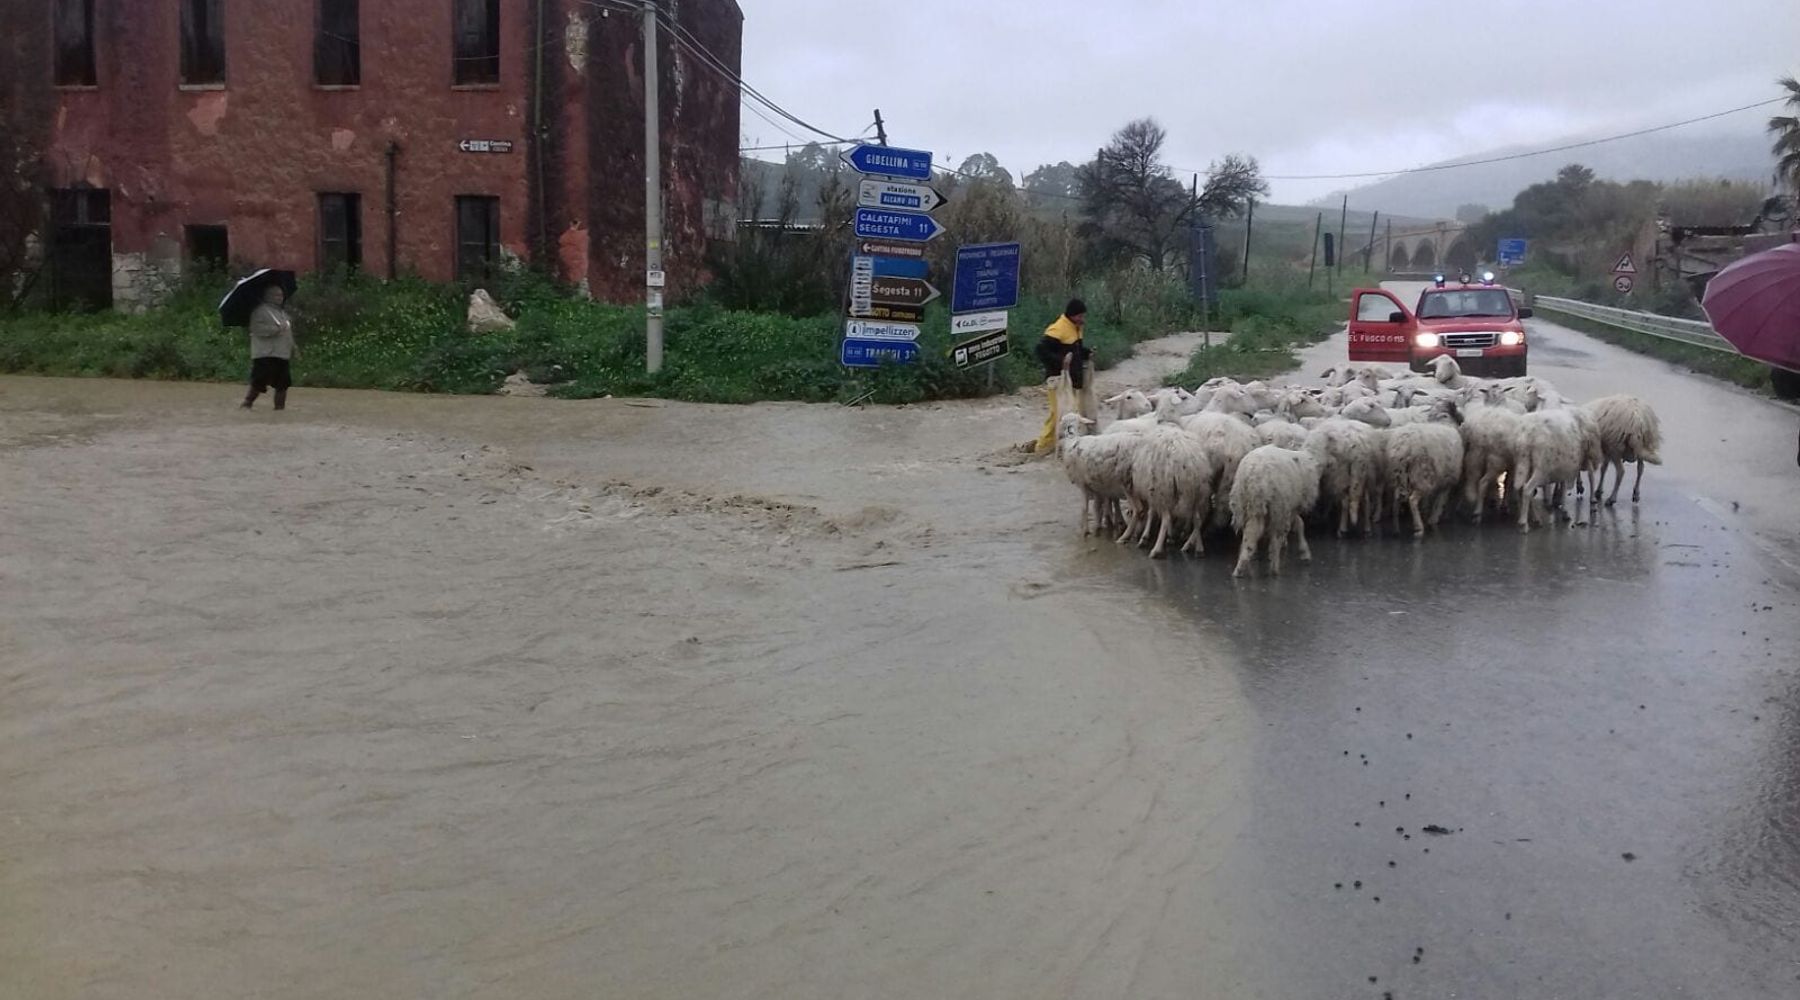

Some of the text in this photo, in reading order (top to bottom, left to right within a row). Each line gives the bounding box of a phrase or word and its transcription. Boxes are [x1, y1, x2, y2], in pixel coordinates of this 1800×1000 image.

[866, 154, 908, 168] GIBELLINA
[887, 186, 916, 194] stazione
[924, 195, 931, 204] 2
[860, 213, 912, 226] CALATAFIMI
[859, 223, 900, 234] SEGESTA
[919, 223, 928, 233] 11
[872, 284, 910, 297] Segesta
[914, 287, 922, 296] 11
